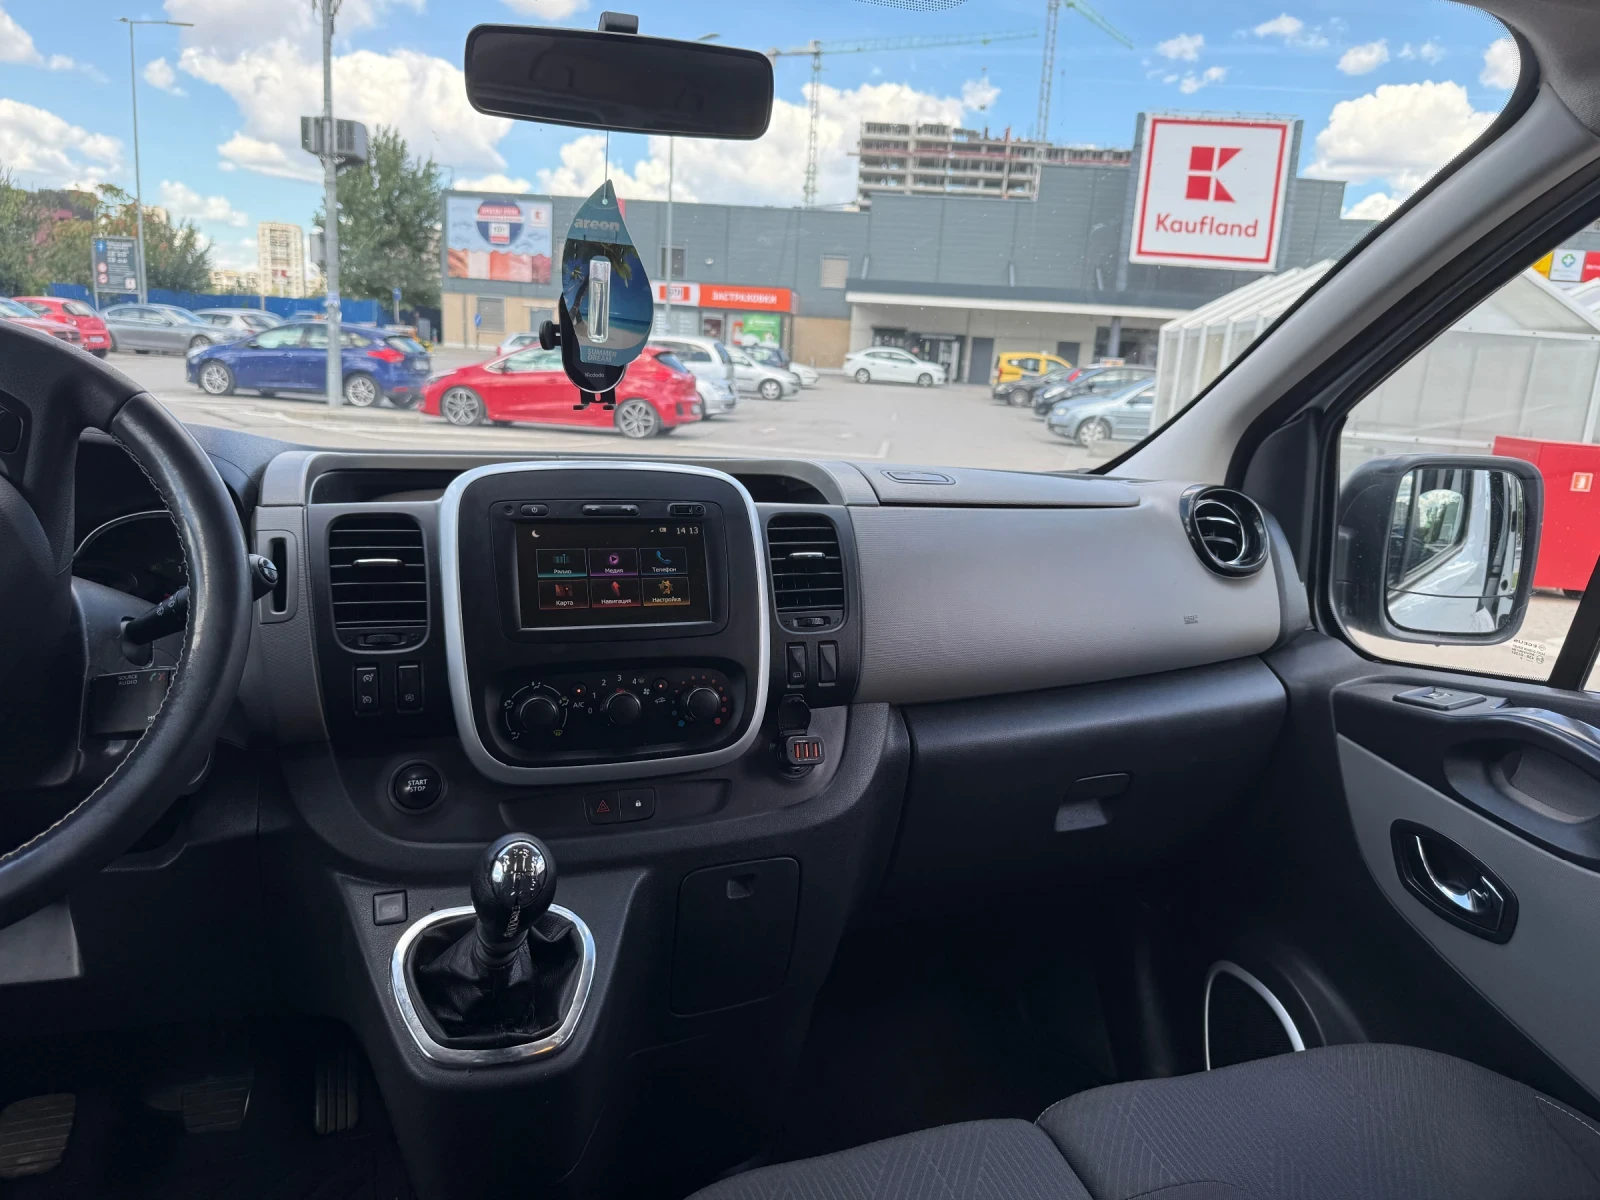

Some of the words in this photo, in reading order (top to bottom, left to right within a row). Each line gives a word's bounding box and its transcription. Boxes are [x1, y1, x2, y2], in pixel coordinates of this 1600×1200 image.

[574, 219, 620, 232] areon
[1155, 213, 1259, 238] Kaufland
[587, 349, 618, 358] SUMMER
[587, 355, 612, 363] DREAM
[676, 527, 686, 535] 14
[689, 527, 699, 535] 13
[617, 674, 622, 682] 3
[601, 679, 607, 687] 2
[587, 707, 593, 715] 0
